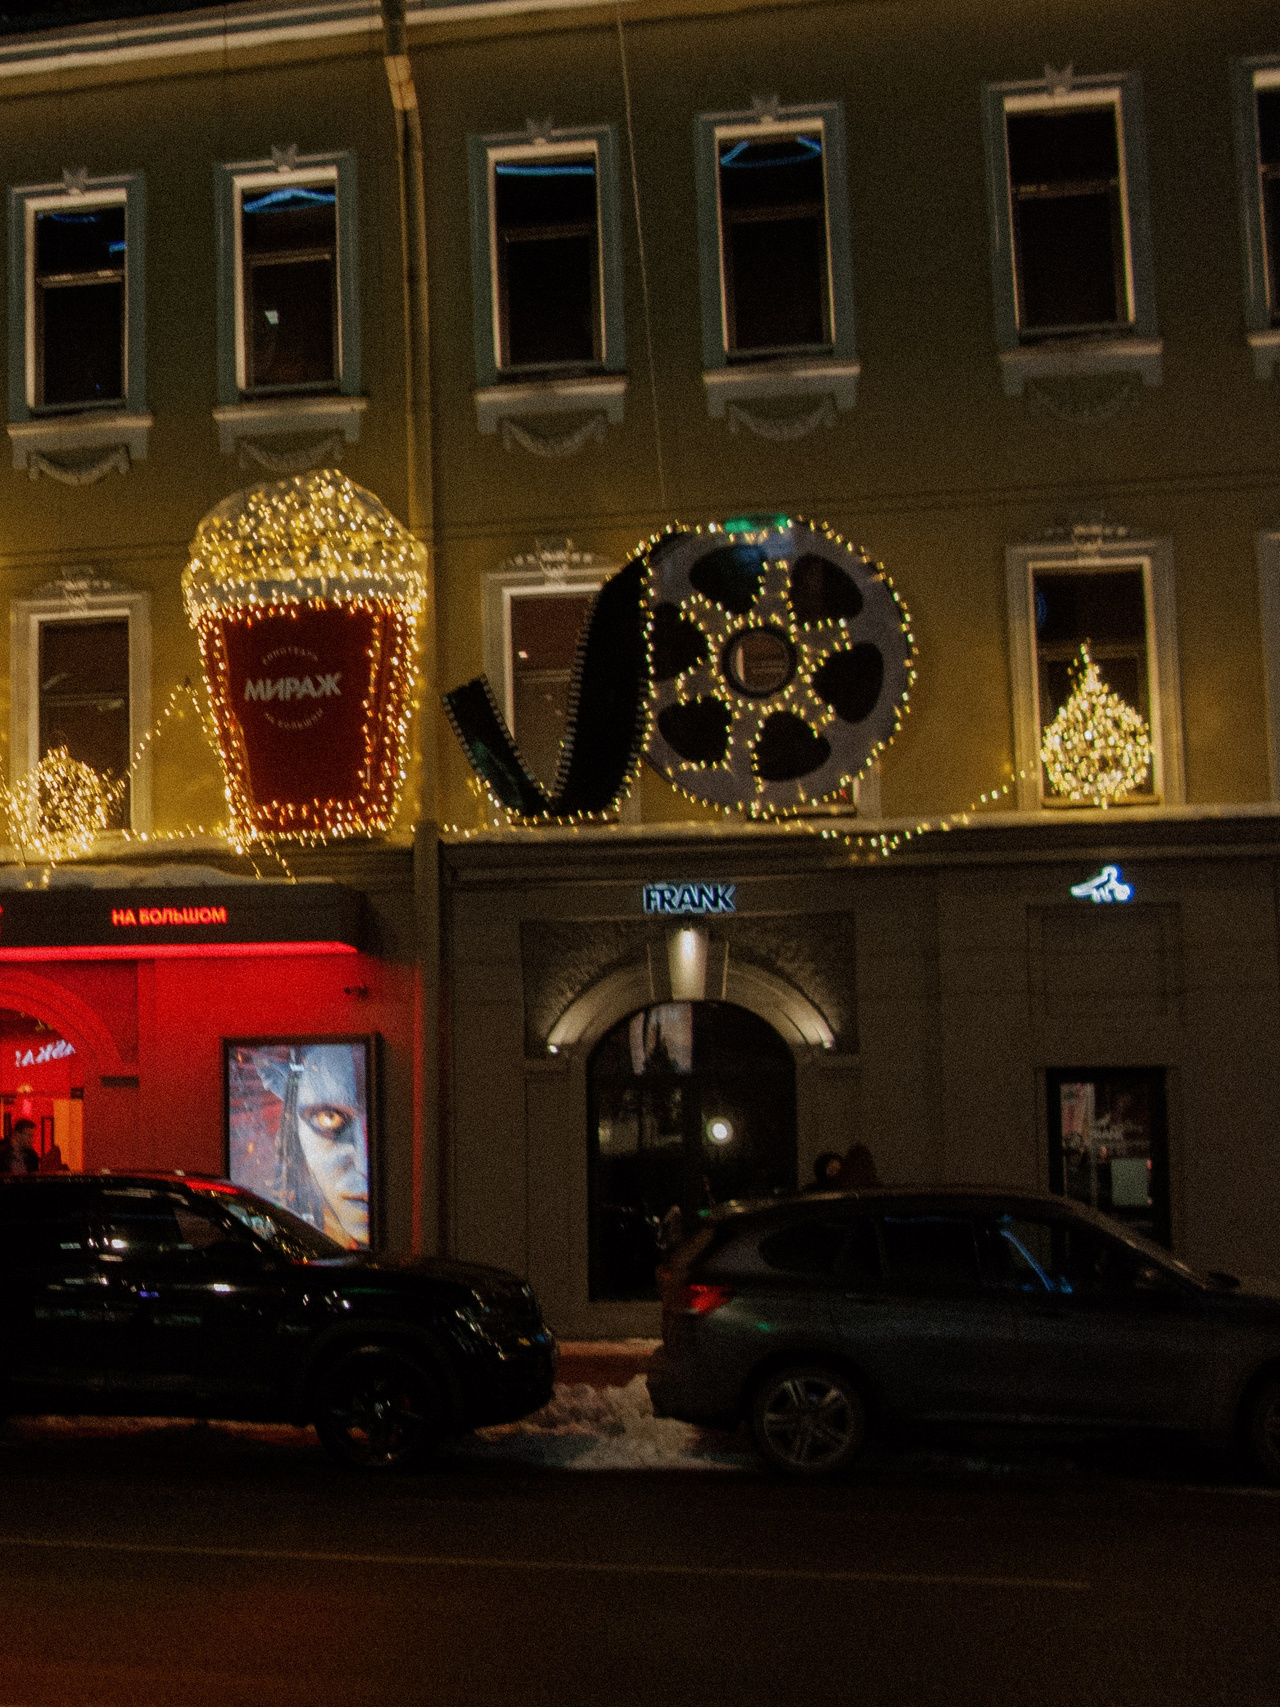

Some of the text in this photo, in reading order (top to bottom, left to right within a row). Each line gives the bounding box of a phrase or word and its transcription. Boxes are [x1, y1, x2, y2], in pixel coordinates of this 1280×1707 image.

[244, 671, 342, 701] МИРАЖ
[642, 883, 736, 914] FRANK
[111, 906, 228, 926] НА БОЛЬШОМ
